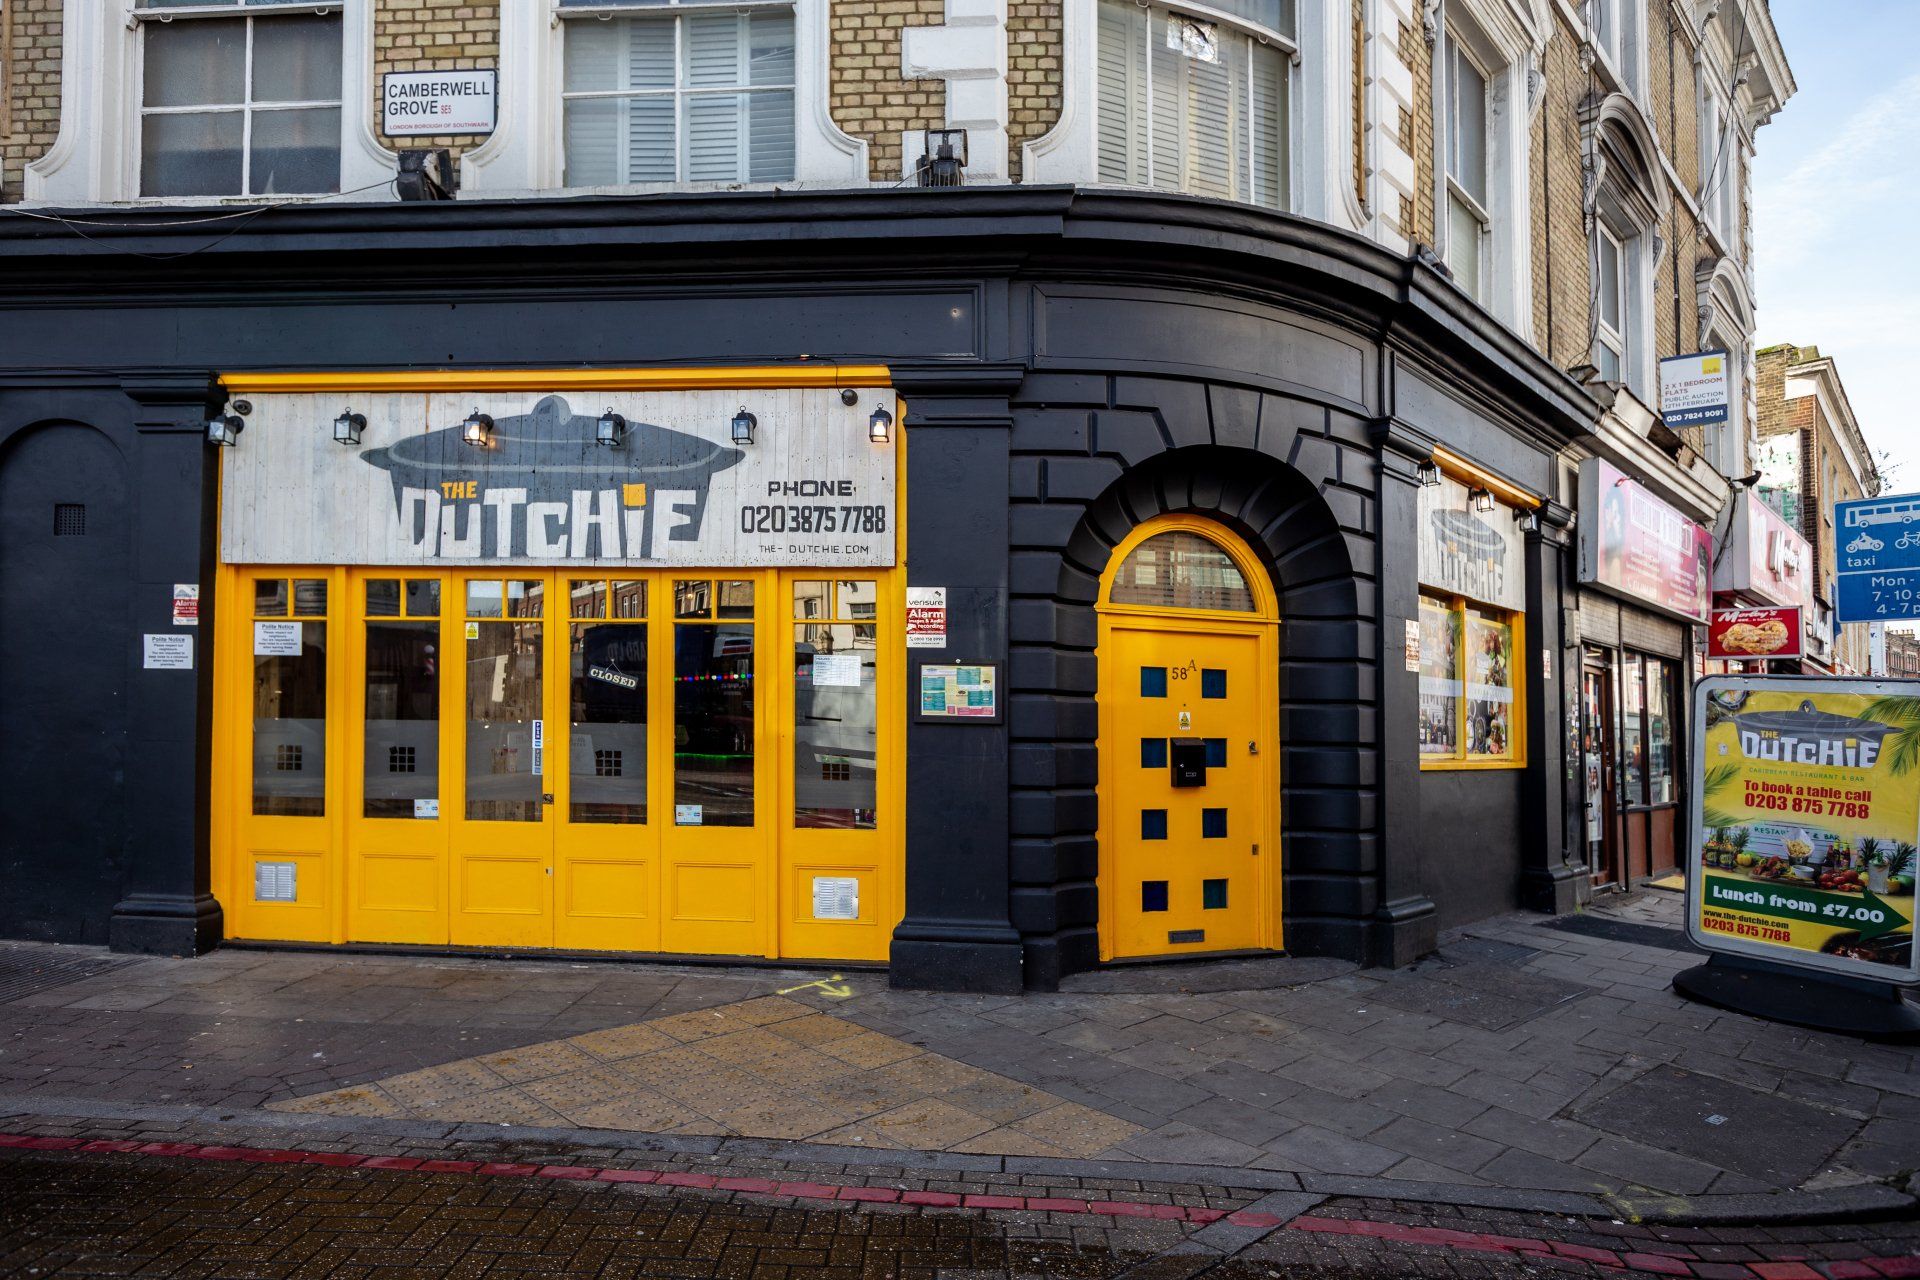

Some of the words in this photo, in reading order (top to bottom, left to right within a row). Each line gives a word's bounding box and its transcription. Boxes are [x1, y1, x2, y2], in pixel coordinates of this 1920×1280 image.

[388, 81, 490, 98] CAMBERWELL
[388, 100, 438, 115] GROVE
[440, 104, 452, 115] SE5
[1684, 377, 1723, 387] BEDROOM
[1664, 395, 1690, 403] PUBLIC
[1691, 391, 1724, 400] AUCTION
[1665, 388, 1689, 396] FLATS
[1682, 398, 1720, 406] FEBRUARY
[1666, 414, 1682, 422] 020
[1684, 412, 1703, 420] 7824
[1705, 409, 1724, 418] 9091
[441, 481, 477, 499] THE
[768, 480, 853, 496] PHONE
[741, 505, 786, 533] 020
[788, 505, 836, 533] 3875
[841, 505, 886, 533] 7788
[1847, 555, 1876, 567] taxi
[1871, 576, 1906, 587] Mon
[1872, 591, 1881, 602] 7
[1894, 589, 1912, 601] 10
[175, 599, 197, 607] Alarm
[1876, 604, 1888, 614] 4
[1899, 602, 1909, 613] 7
[909, 609, 944, 618] Alarm
[590, 668, 636, 688] CLOSED
[1760, 730, 1779, 739] THE
[1749, 767, 1788, 775] CARIBBEAN
[1790, 770, 1838, 780] RESTAURANT
[1744, 780, 1759, 791] To
[1761, 782, 1793, 795] book
[1796, 786, 1804, 796] a
[1806, 786, 1842, 799] table
[1844, 790, 1872, 802] call
[1744, 792, 1788, 811] 0203
[1791, 796, 1823, 814] 875
[1827, 800, 1870, 819] 7788
[1713, 885, 1765, 905] Lunch
[1769, 894, 1817, 914] from
[1822, 903, 1885, 924] £7.00
[1703, 909, 1789, 930] www.the-dutchie.com
[1703, 917, 1734, 932] 0203
[1736, 922, 1759, 937] 875
[1762, 927, 1791, 943] 7788
